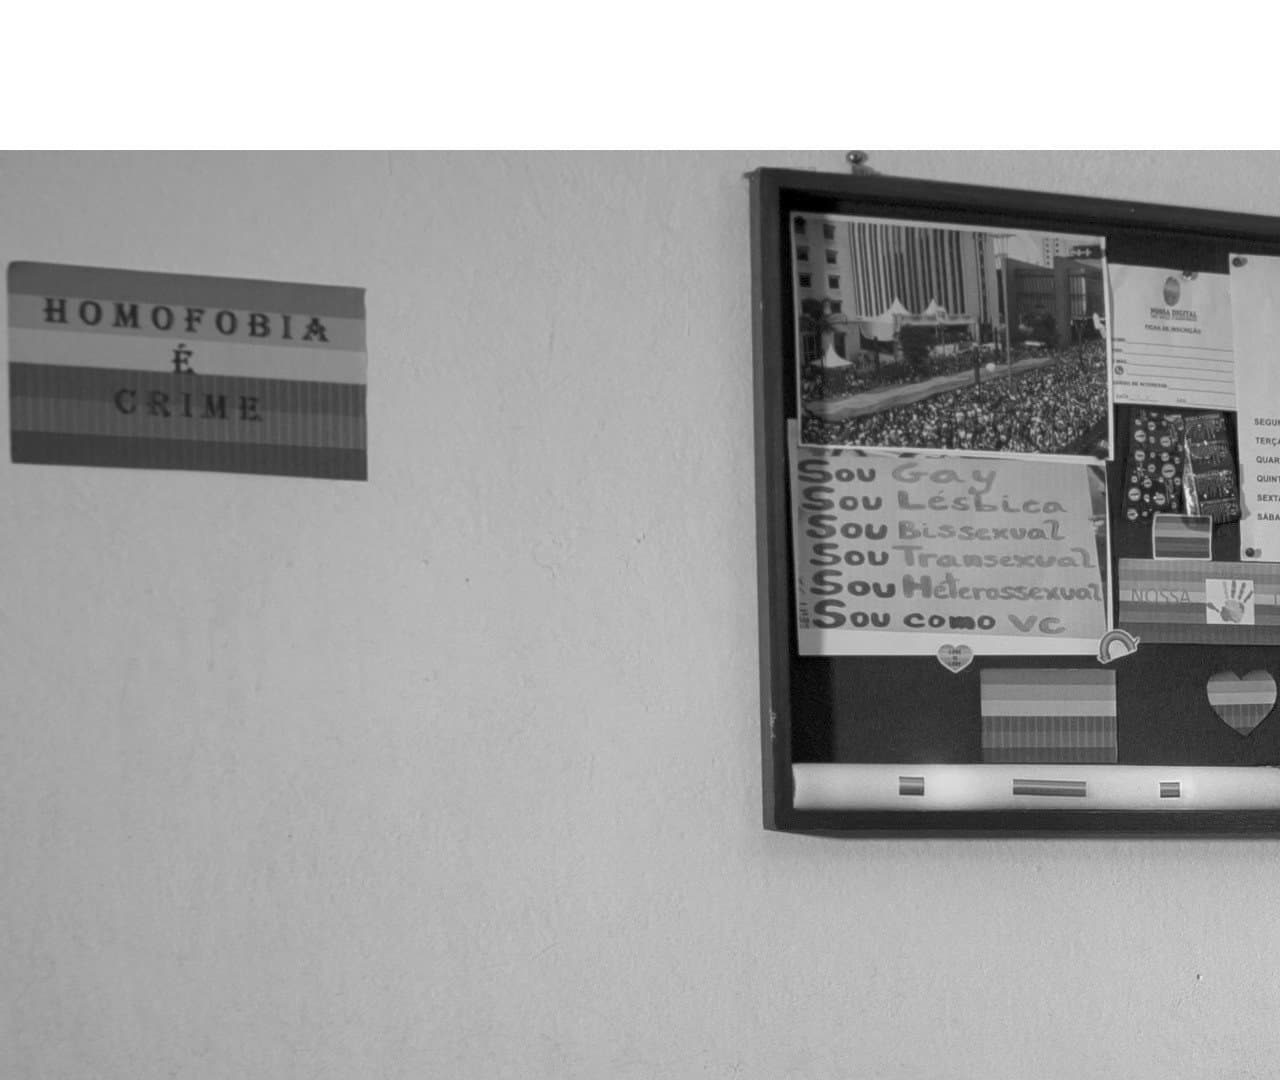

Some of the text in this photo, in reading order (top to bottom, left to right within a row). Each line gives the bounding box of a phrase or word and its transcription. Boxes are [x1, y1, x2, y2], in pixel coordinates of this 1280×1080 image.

[43, 298, 330, 343] HOMOFOBIA
[172, 344, 195, 375] É
[113, 388, 264, 422] CRIME
[797, 458, 997, 495] Sou Gay
[801, 485, 883, 511] Sou
[806, 514, 1066, 541] Sou Bissexual
[809, 543, 1097, 568] Sou Transexual
[809, 569, 896, 598] Sou
[1131, 588, 1191, 605] NOSSA
[812, 599, 891, 629] Sou
[903, 612, 996, 631] como
